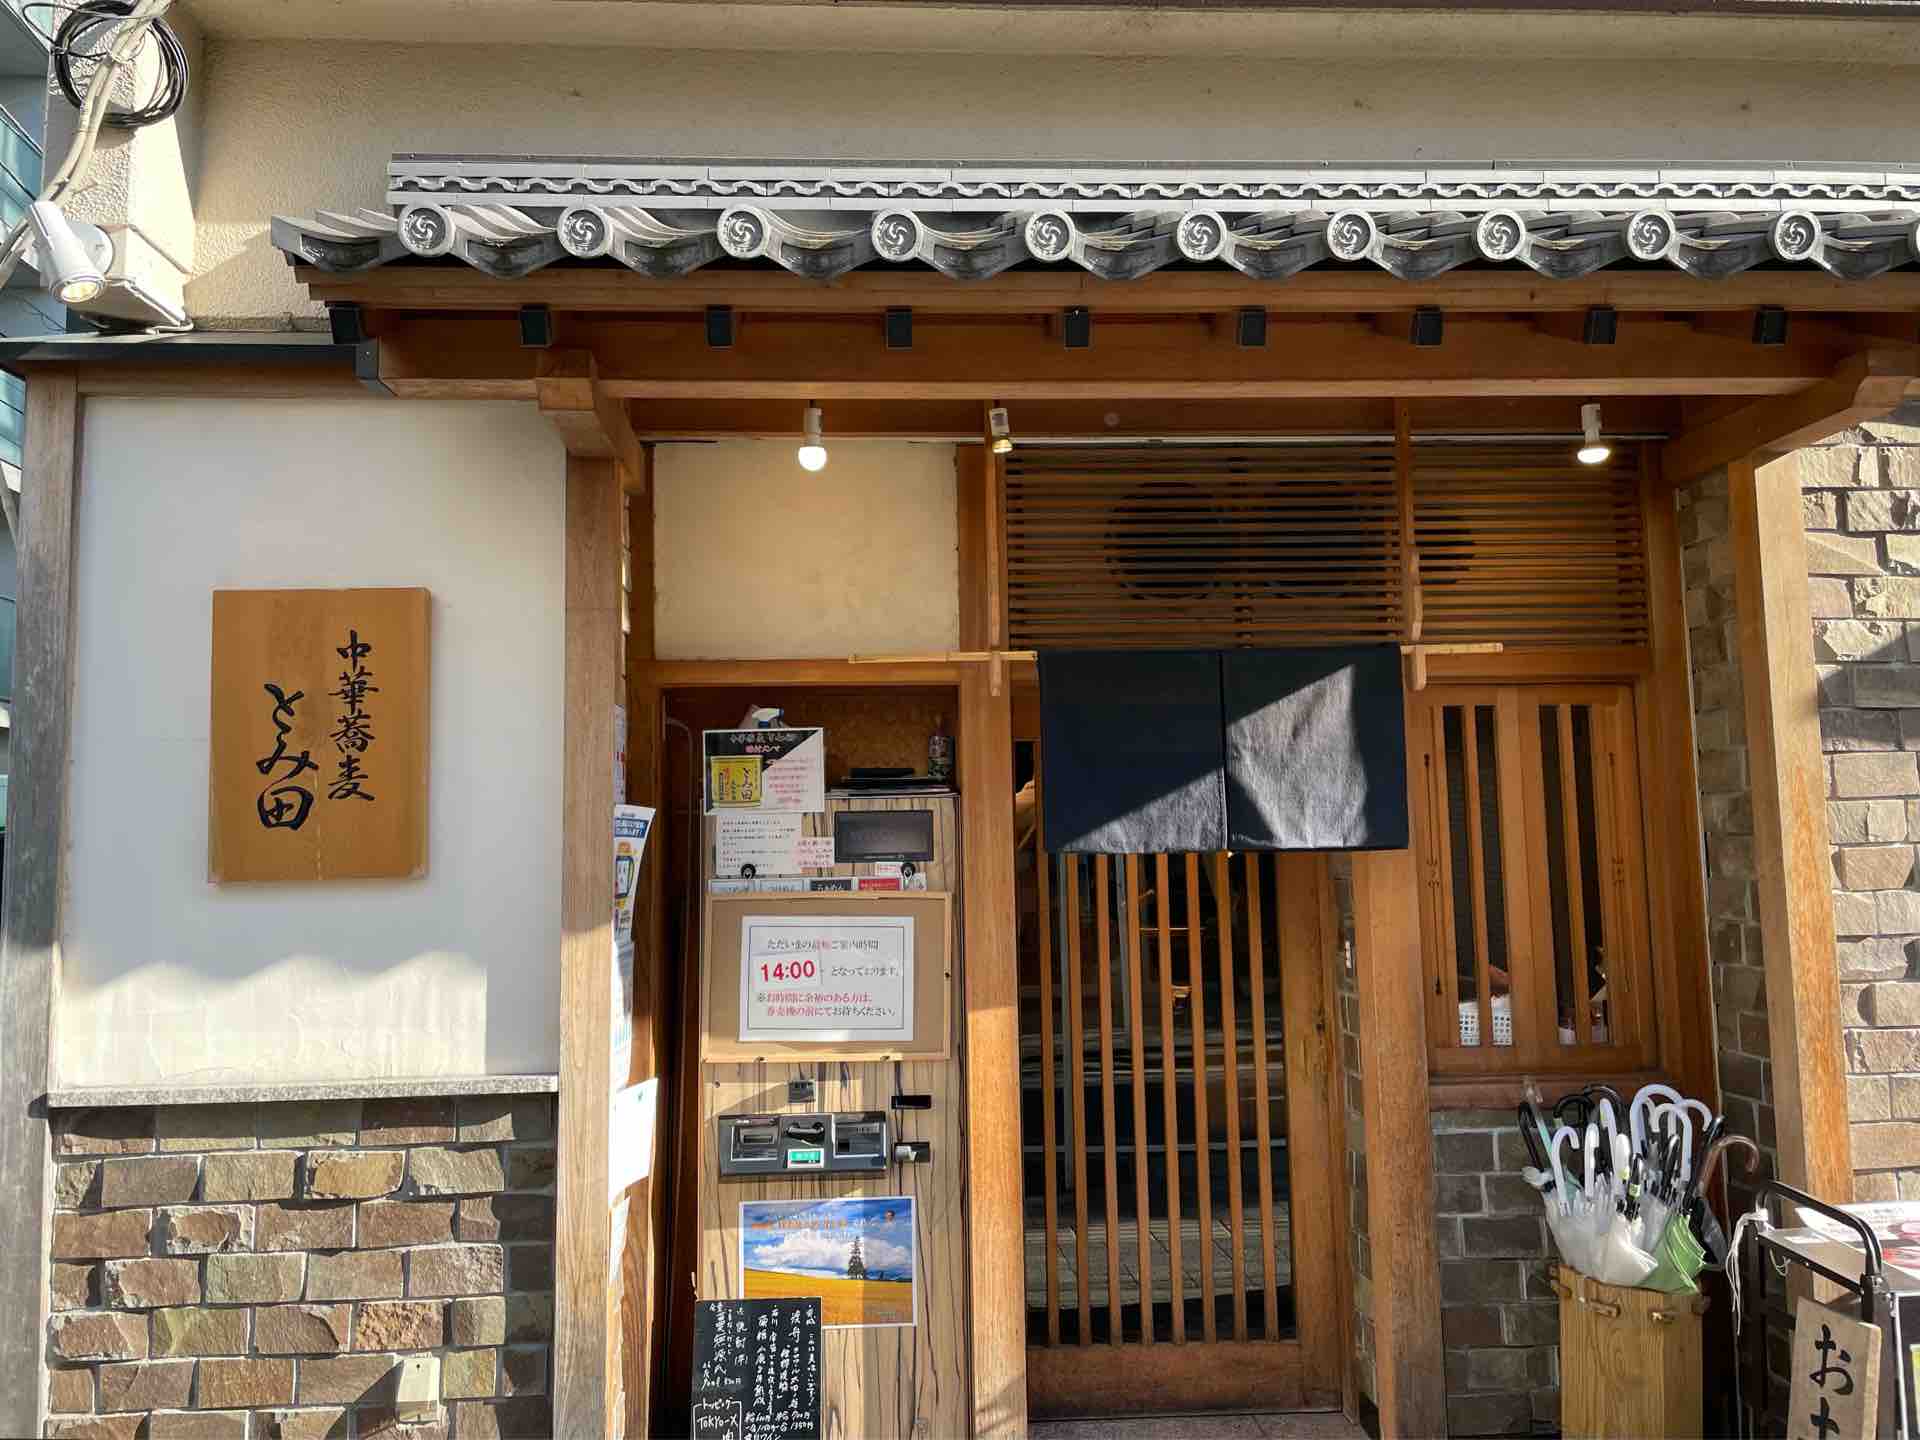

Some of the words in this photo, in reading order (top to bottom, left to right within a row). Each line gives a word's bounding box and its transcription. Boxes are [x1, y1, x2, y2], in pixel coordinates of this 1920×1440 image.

[256, 683, 320, 831] とみ田
[328, 629, 379, 801] 中華蕎麦
[761, 959, 816, 982] 14:00
